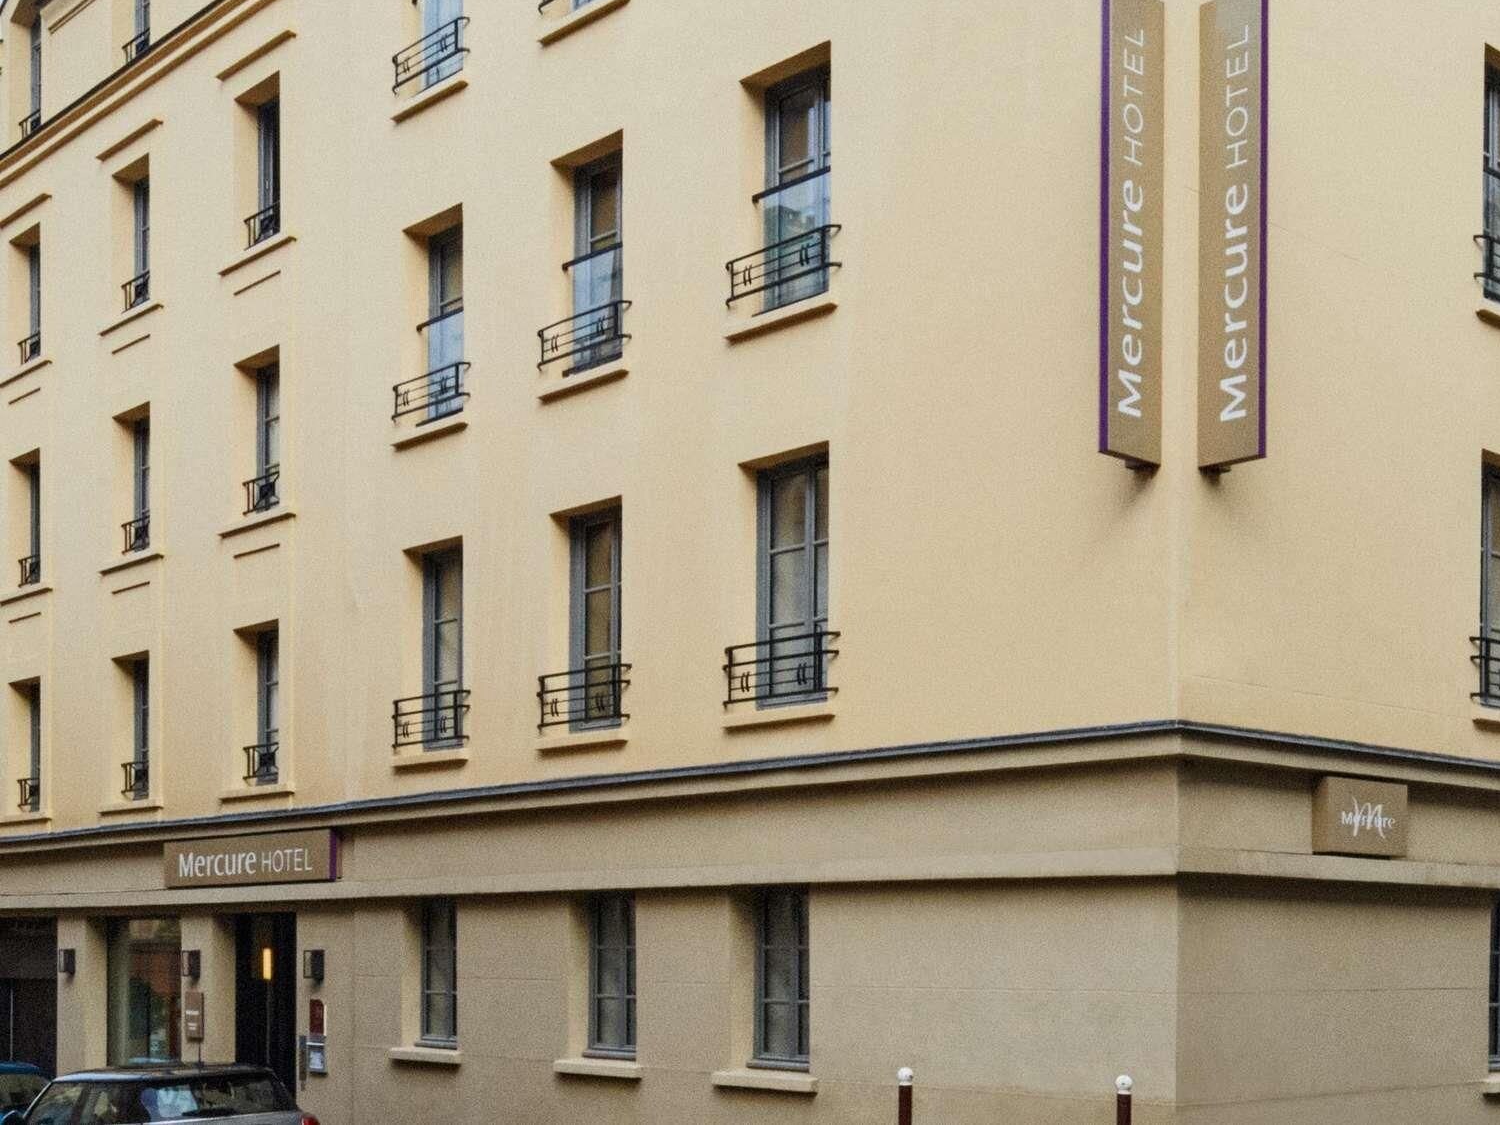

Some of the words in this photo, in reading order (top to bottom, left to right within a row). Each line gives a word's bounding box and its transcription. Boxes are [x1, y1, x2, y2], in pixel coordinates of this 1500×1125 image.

[1123, 28, 1144, 166] HOTEL
[1226, 24, 1248, 169] HOTEL
[1118, 179, 1143, 417] Mercure
[1219, 183, 1248, 422] Mercure
[178, 851, 257, 877] Mercure
[261, 848, 313, 872] HOTEL
